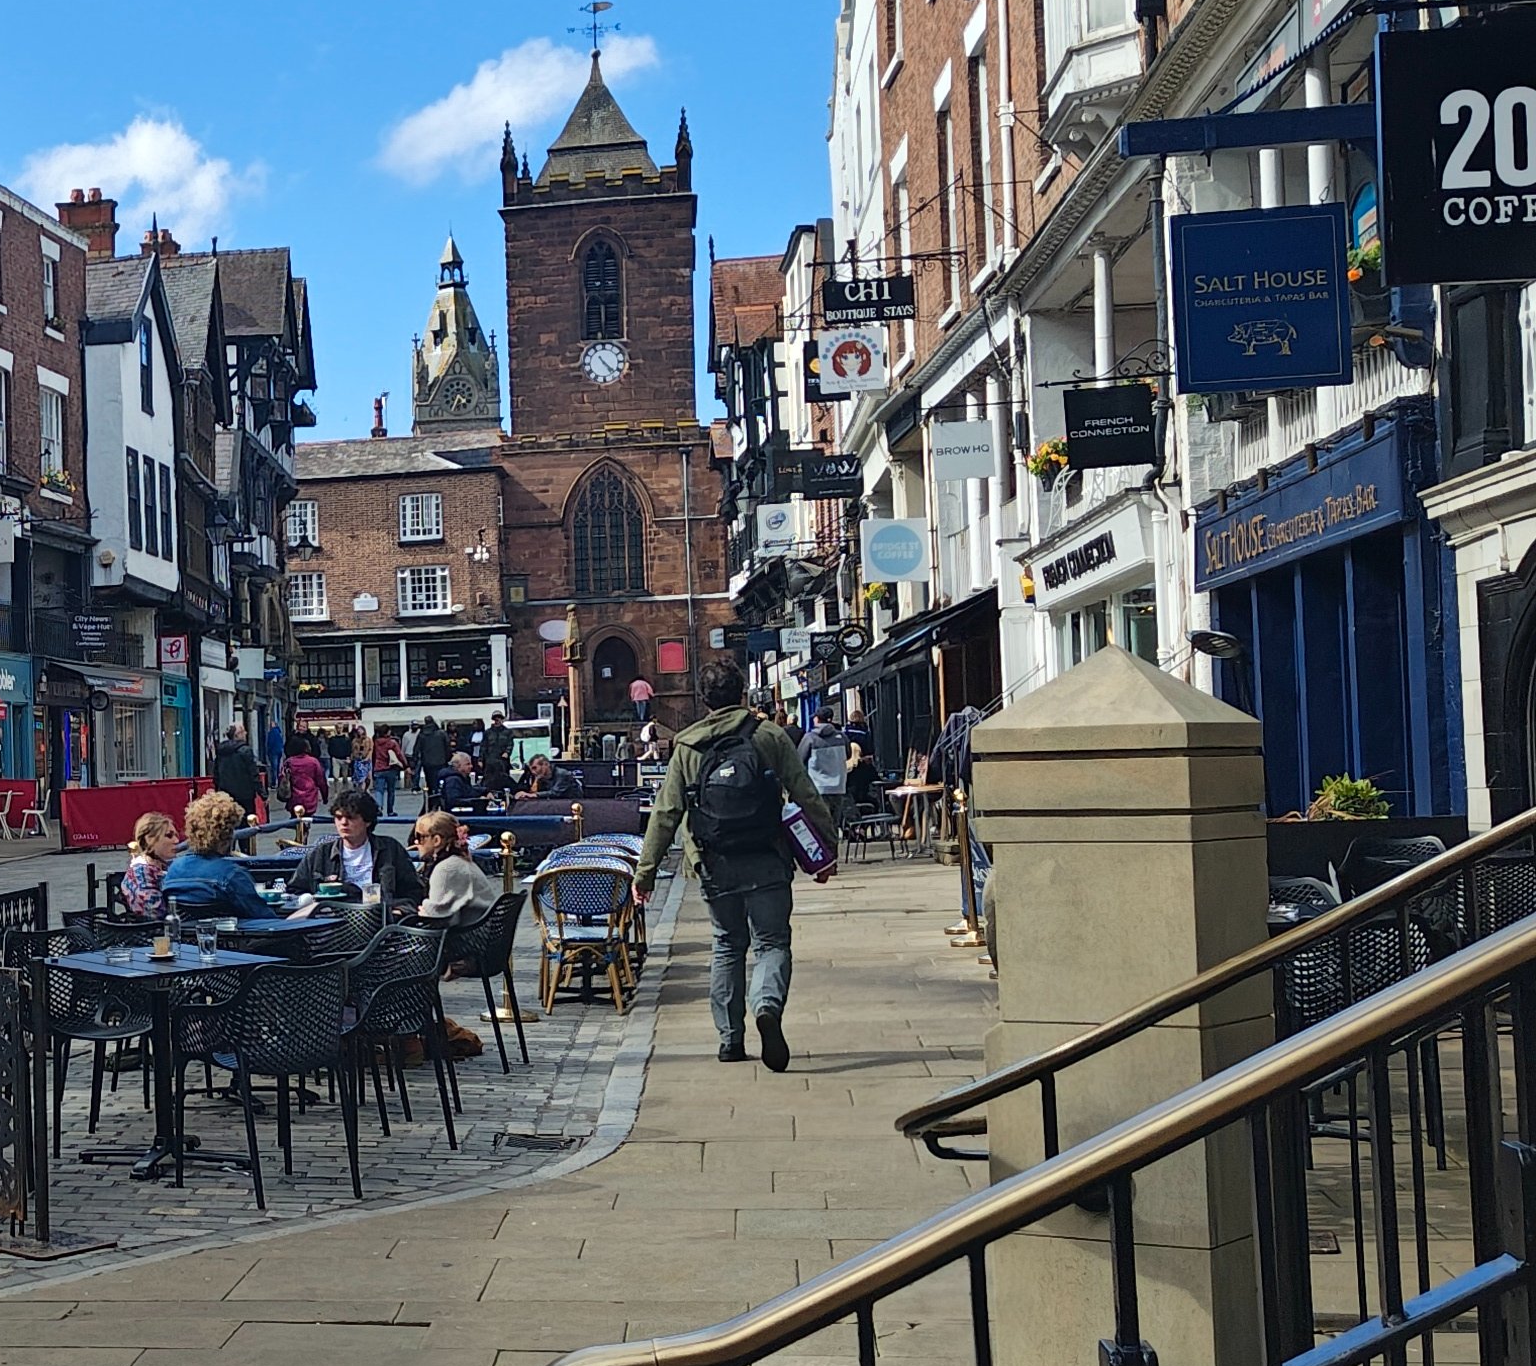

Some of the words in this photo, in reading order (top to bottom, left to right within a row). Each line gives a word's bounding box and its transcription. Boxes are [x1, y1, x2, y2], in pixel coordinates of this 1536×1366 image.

[1194, 275, 1246, 294] SALT
[1254, 270, 1328, 290] HOUSE
[844, 281, 891, 301] CHI
[1275, 293, 1305, 302] TAPAS
[1309, 291, 1329, 300] BAR
[825, 308, 877, 321] BOUTIQUE
[883, 304, 914, 317] STAYS
[1084, 416, 1133, 427] FRENCH
[1070, 425, 1149, 439] CONNECTION
[936, 446, 971, 456] BROW
[972, 444, 990, 453] HQ
[1205, 530, 1229, 575] SALT
[1229, 514, 1266, 565] HOUSE
[1355, 484, 1378, 516] BAR
